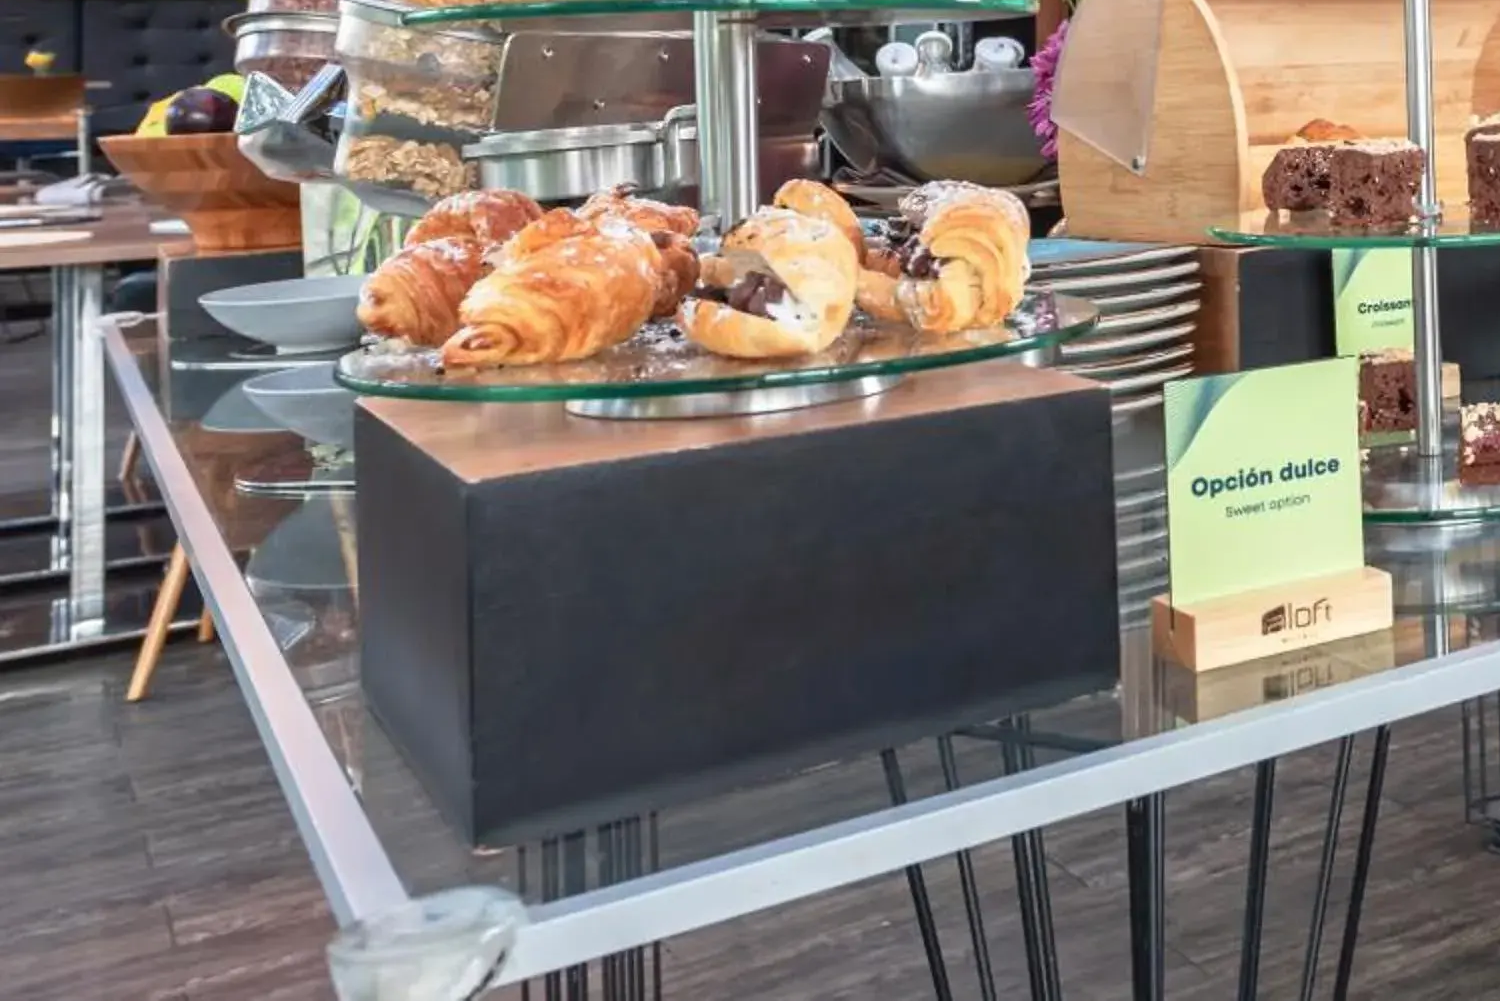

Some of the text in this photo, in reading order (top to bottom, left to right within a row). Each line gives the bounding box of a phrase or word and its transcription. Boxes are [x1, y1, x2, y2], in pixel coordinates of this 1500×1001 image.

[1357, 300, 1411, 314] Croissan
[1191, 457, 1340, 498] Opción dulce
[1225, 492, 1311, 518] Sweet option
